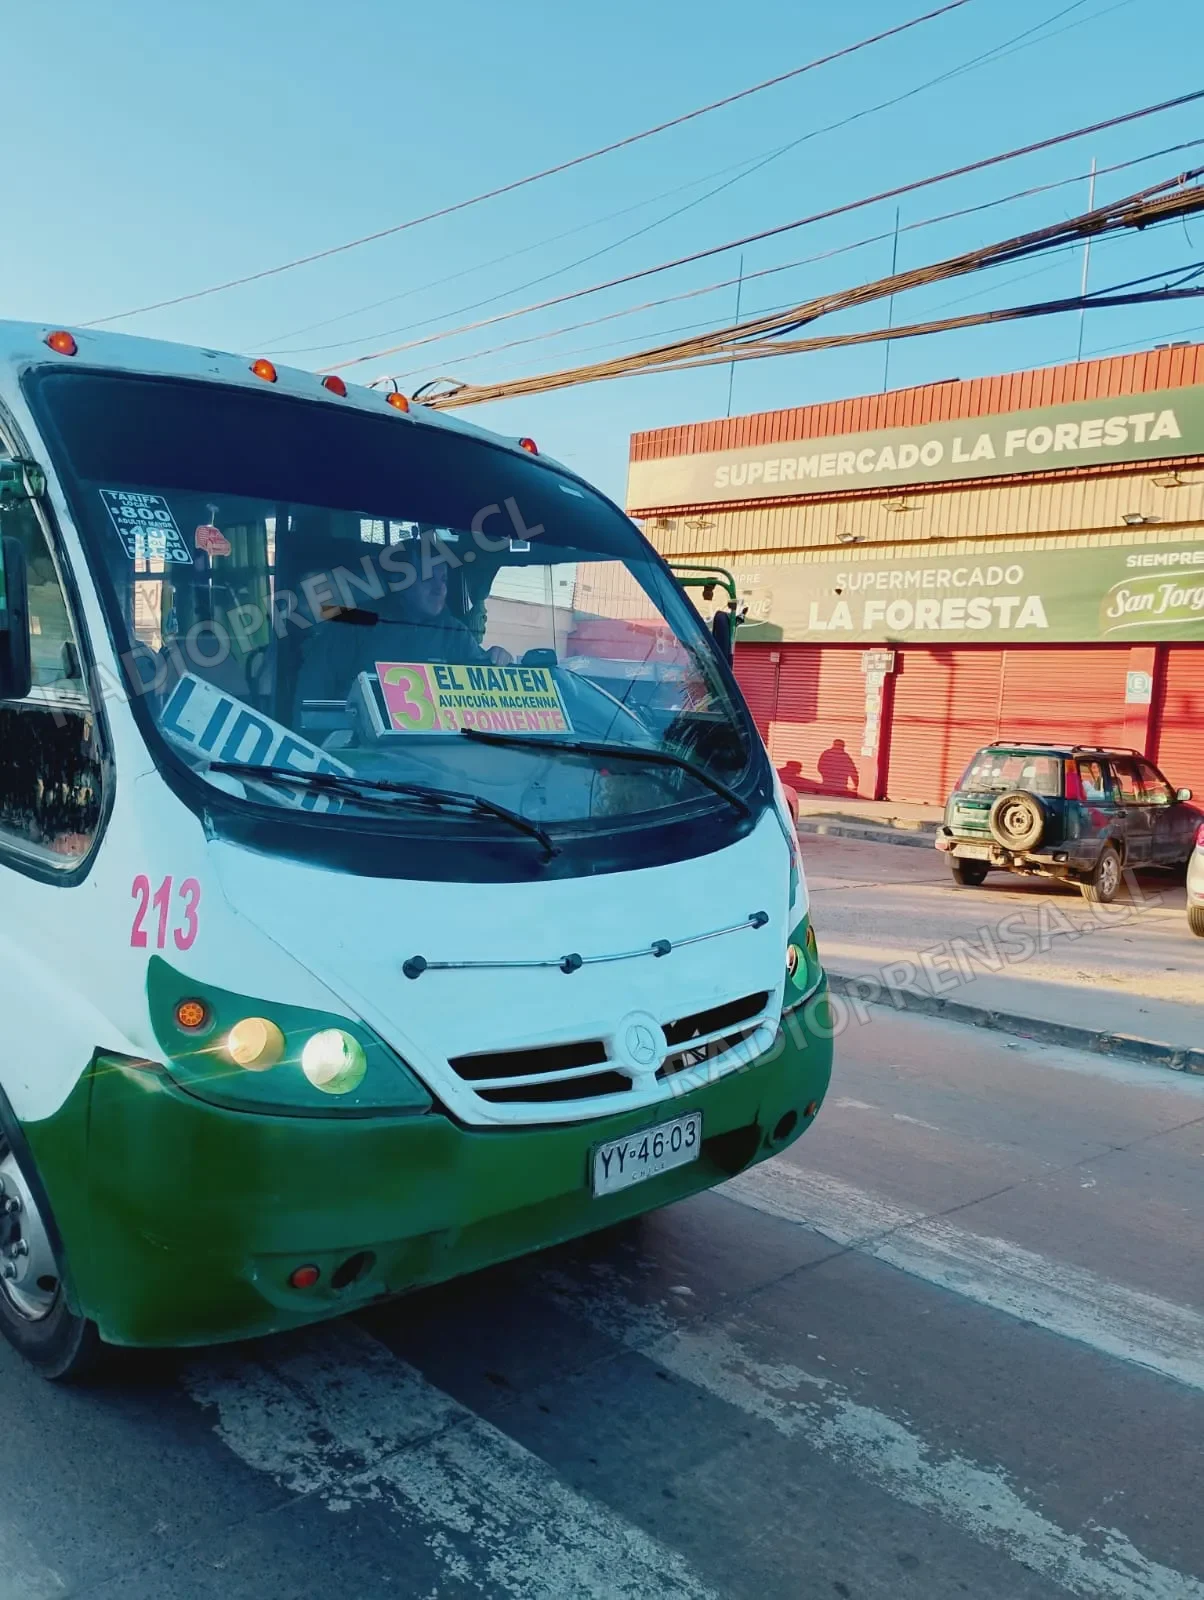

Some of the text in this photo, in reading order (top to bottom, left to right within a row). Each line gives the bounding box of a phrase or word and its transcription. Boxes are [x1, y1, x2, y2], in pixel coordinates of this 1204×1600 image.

[713, 409, 1182, 489] SUPERMERCADO LA FORESTA
[108, 492, 160, 504] TARIFA
[122, 500, 150, 508] LOCAL
[118, 517, 174, 529] ADULTO MAYOR
[1126, 551, 1204, 568] SIEMPRE
[836, 565, 1024, 591] SUPERMERCADO
[808, 595, 1049, 630] LA FORESTA
[1106, 589, 1155, 618] San
[433, 666, 549, 693] EL MAITEN
[384, 667, 435, 731] 3
[499, 695, 559, 709] MACKENNA
[443, 709, 566, 731] 3 PONIENTE
[130, 874, 201, 951] 213
